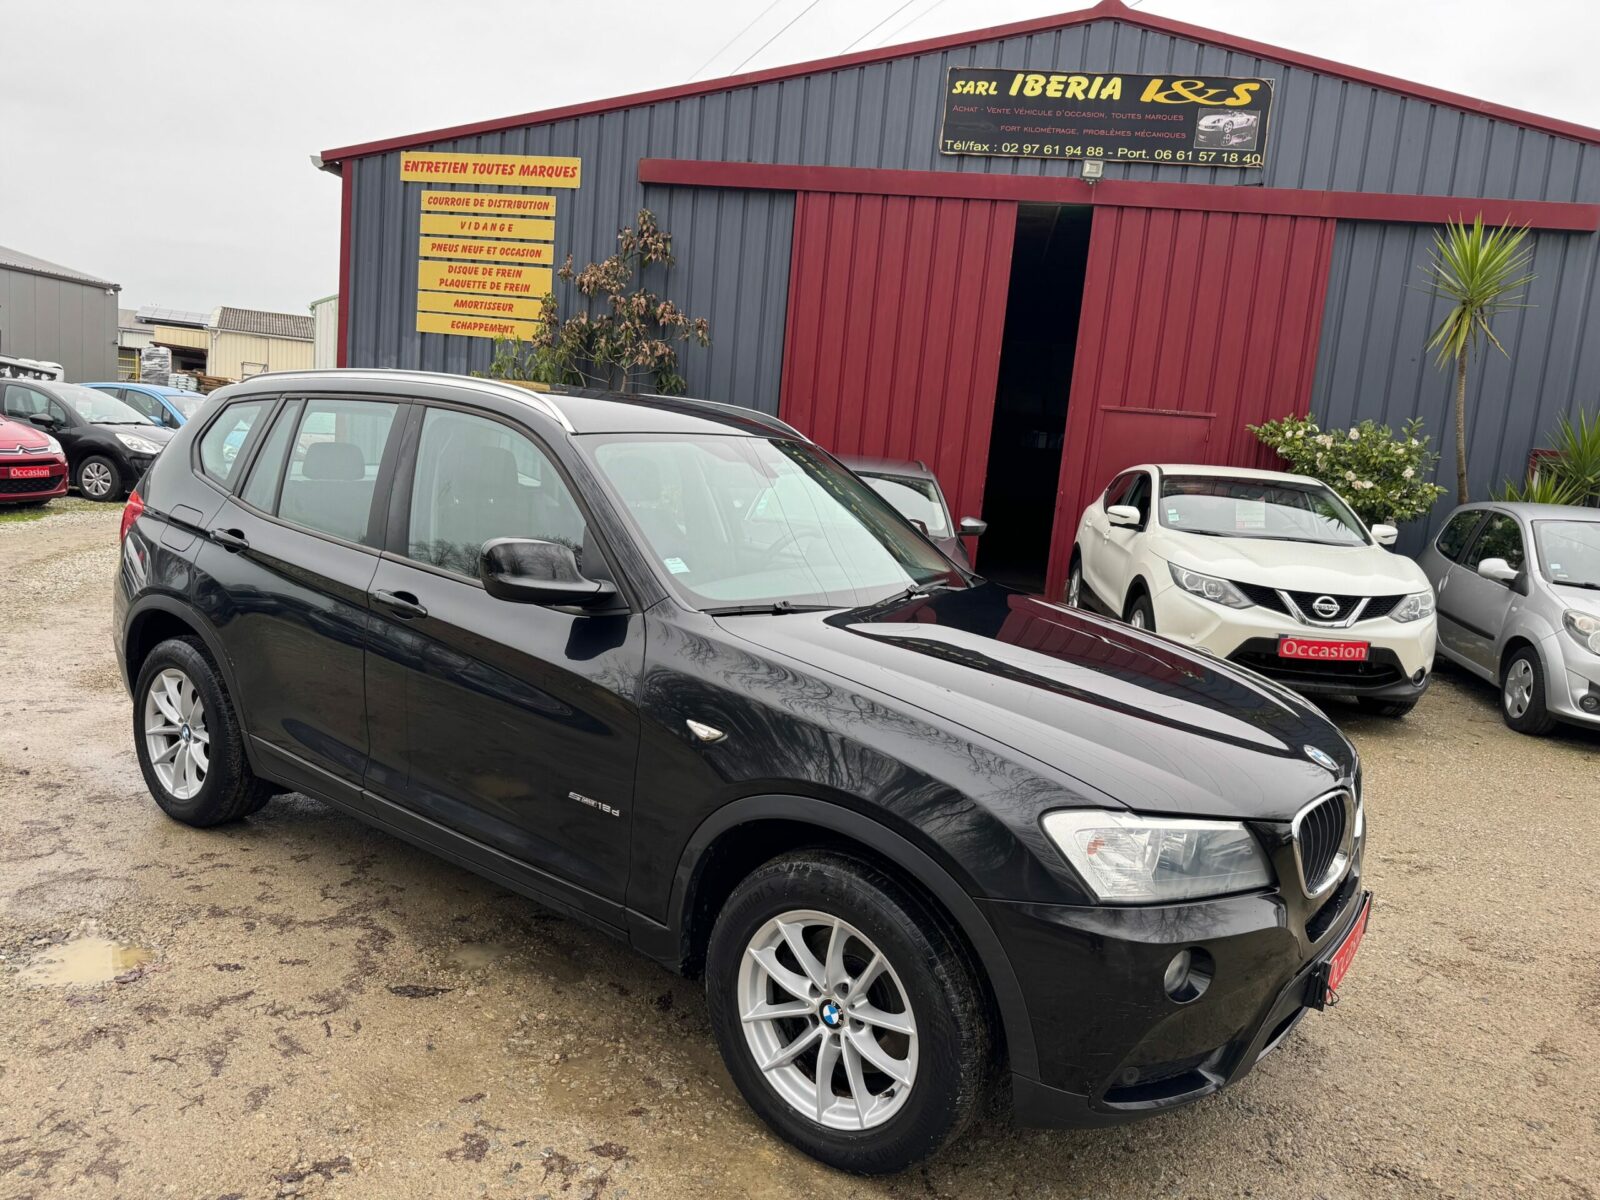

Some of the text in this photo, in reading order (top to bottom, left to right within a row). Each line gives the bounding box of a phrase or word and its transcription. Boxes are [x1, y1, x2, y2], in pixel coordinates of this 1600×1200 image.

[952, 80, 998, 95] SARL
[1008, 73, 1122, 101] IBERIA
[1111, 112, 1142, 120] TOUTES
[1001, 142, 1019, 153] 02
[1023, 143, 1040, 154] 97
[1043, 144, 1060, 155] 61
[1065, 145, 1082, 156] 94
[1086, 146, 1104, 157] 88
[1117, 147, 1150, 159] Port.
[1154, 149, 1172, 160] 06
[1176, 150, 1193, 161] 61
[1198, 151, 1217, 162] 57
[1221, 152, 1238, 163] 18
[1242, 153, 1261, 164] 40
[404, 160, 577, 178] ENTRETIEN TOUTES MARQUES
[427, 196, 549, 210] COURROIE DE DISTRIBUTION
[460, 221, 514, 232] VIDANGE
[431, 243, 542, 258] PNEUS NEUF ET OCCASION
[448, 265, 522, 278] DISQUE DE FREIN
[439, 278, 531, 292] PLAQUETTE DE FREIN
[453, 299, 514, 312] AMORTISSEUR
[11, 467, 49, 477] Occasion
[1282, 640, 1365, 658] Occasion
